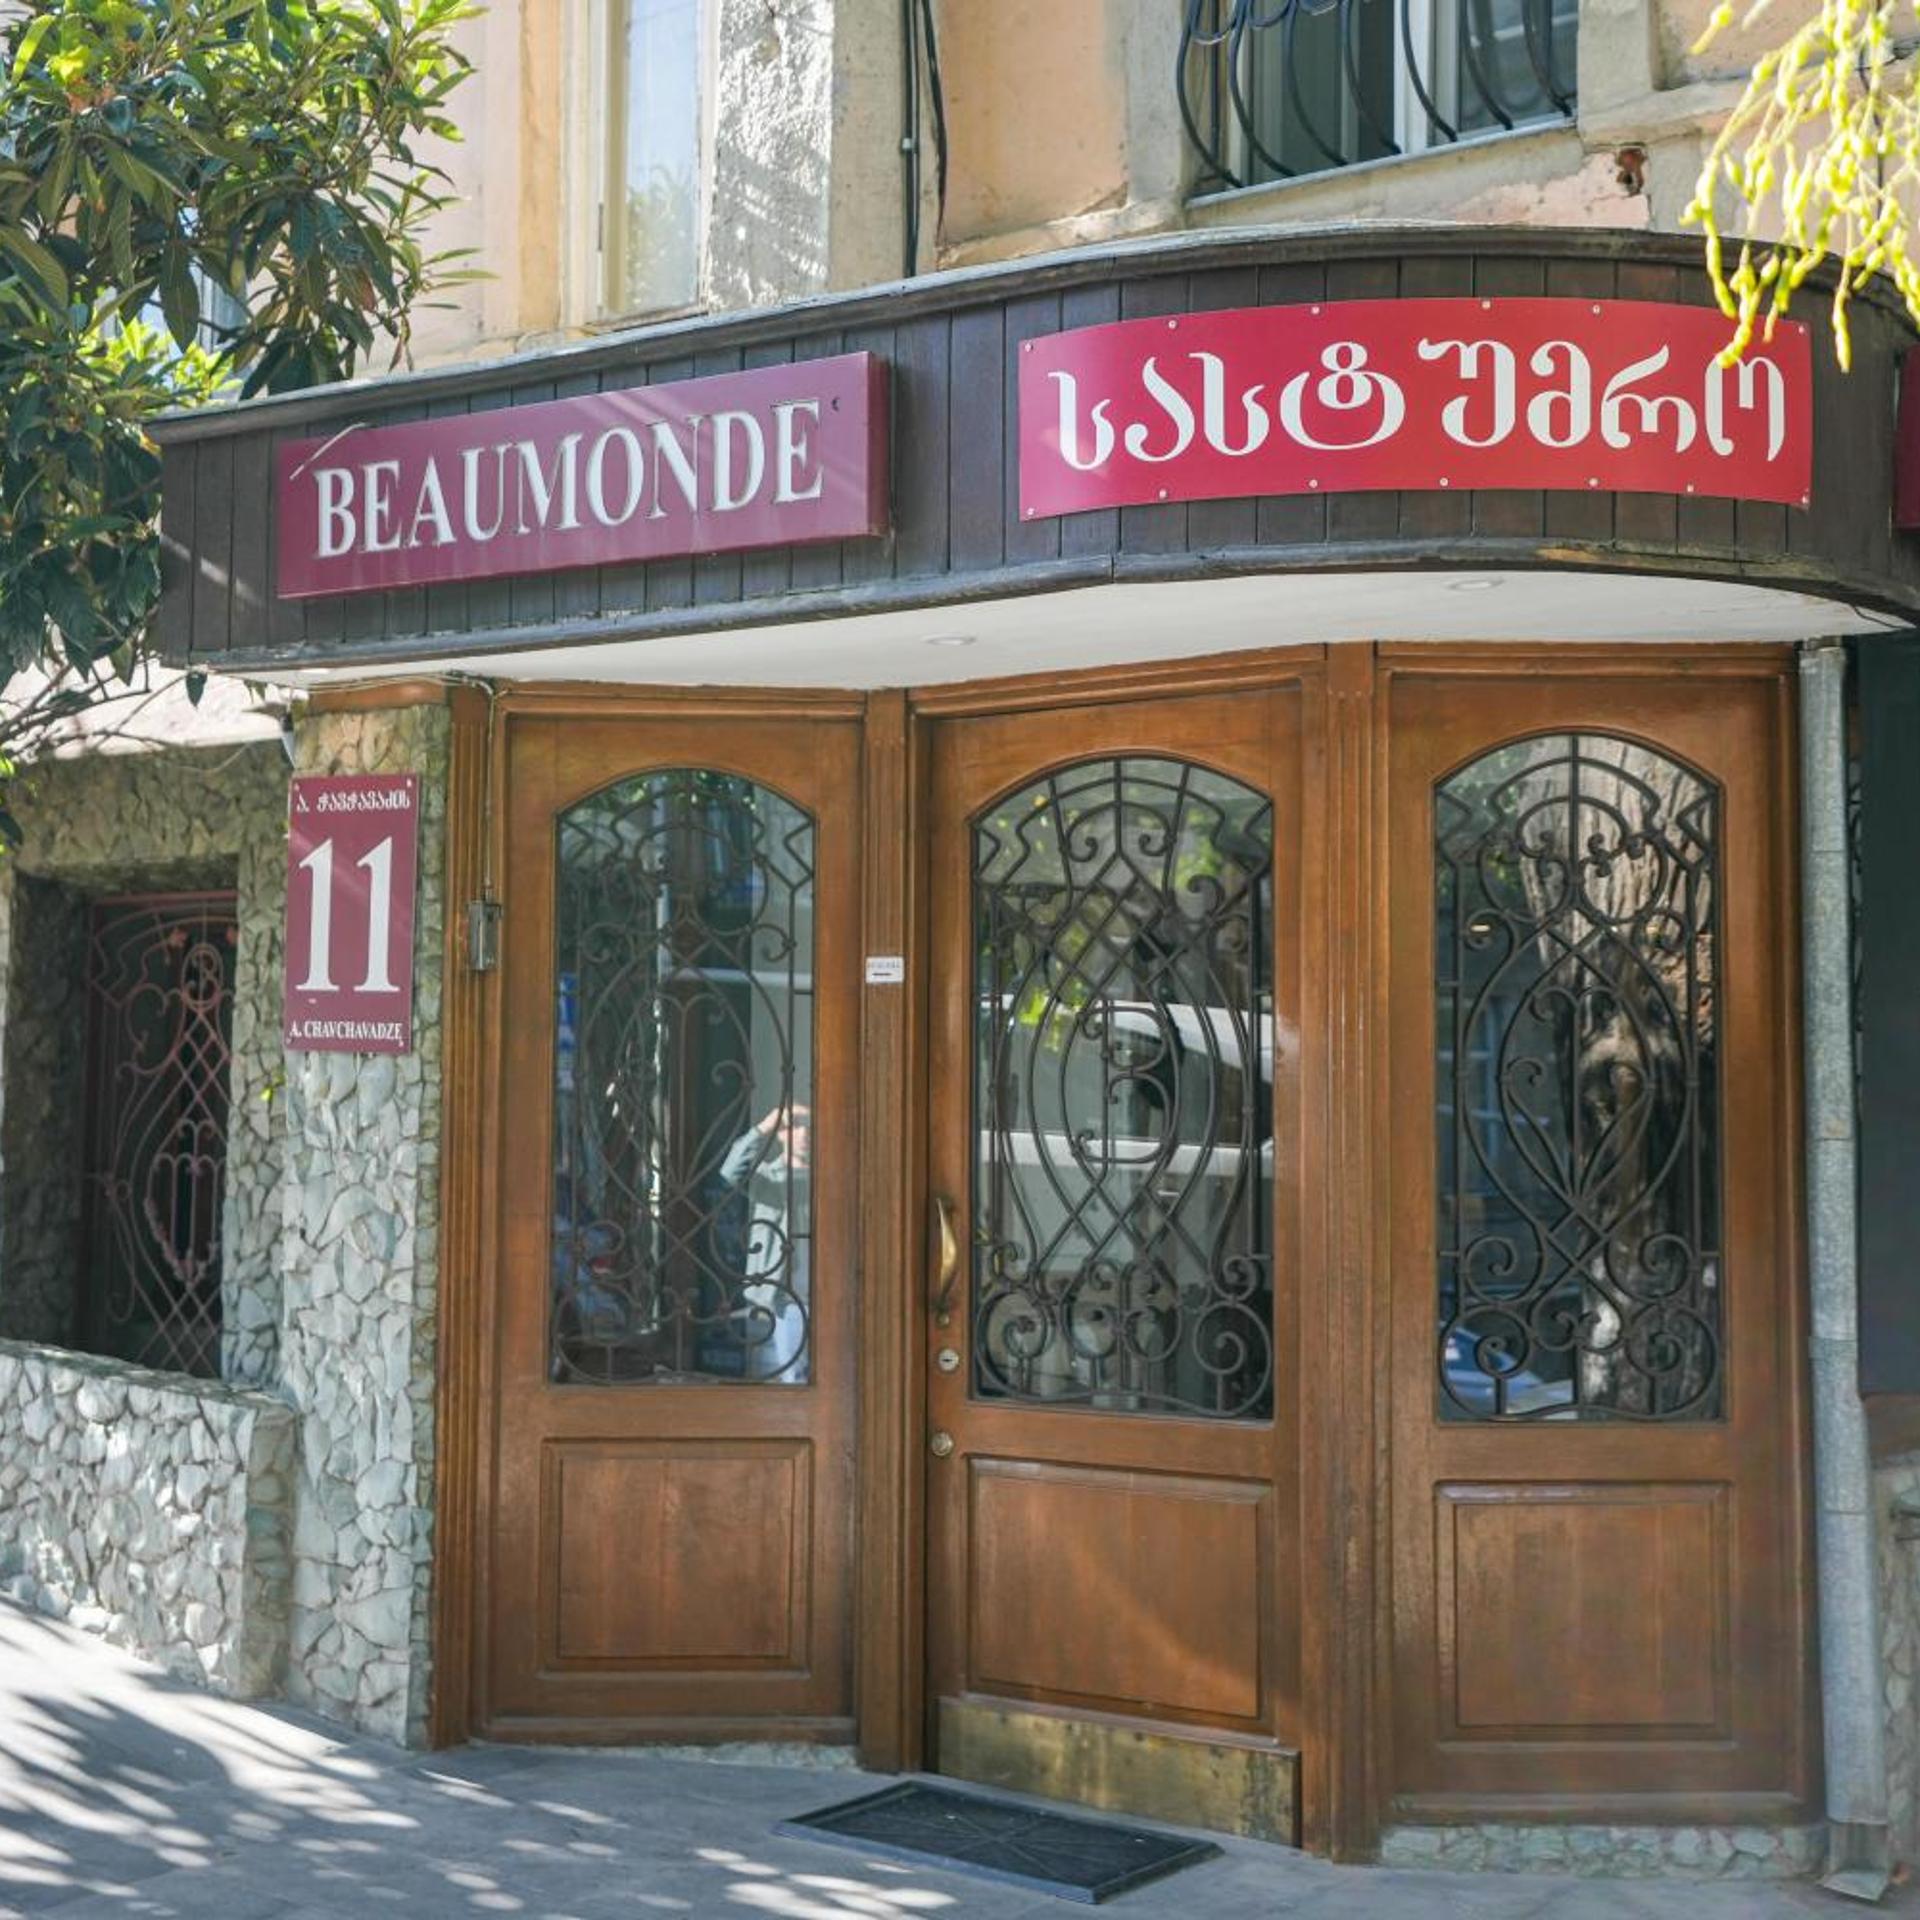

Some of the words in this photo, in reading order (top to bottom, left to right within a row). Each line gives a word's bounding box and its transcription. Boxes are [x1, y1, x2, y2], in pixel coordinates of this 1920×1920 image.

[1048, 336, 1785, 471] სასტუმრო
[313, 399, 823, 559] BEAUMONDE
[295, 837, 400, 993] 11
[289, 1020, 302, 1038] A.
[304, 1020, 403, 1040] CHAVCHAVADZE
